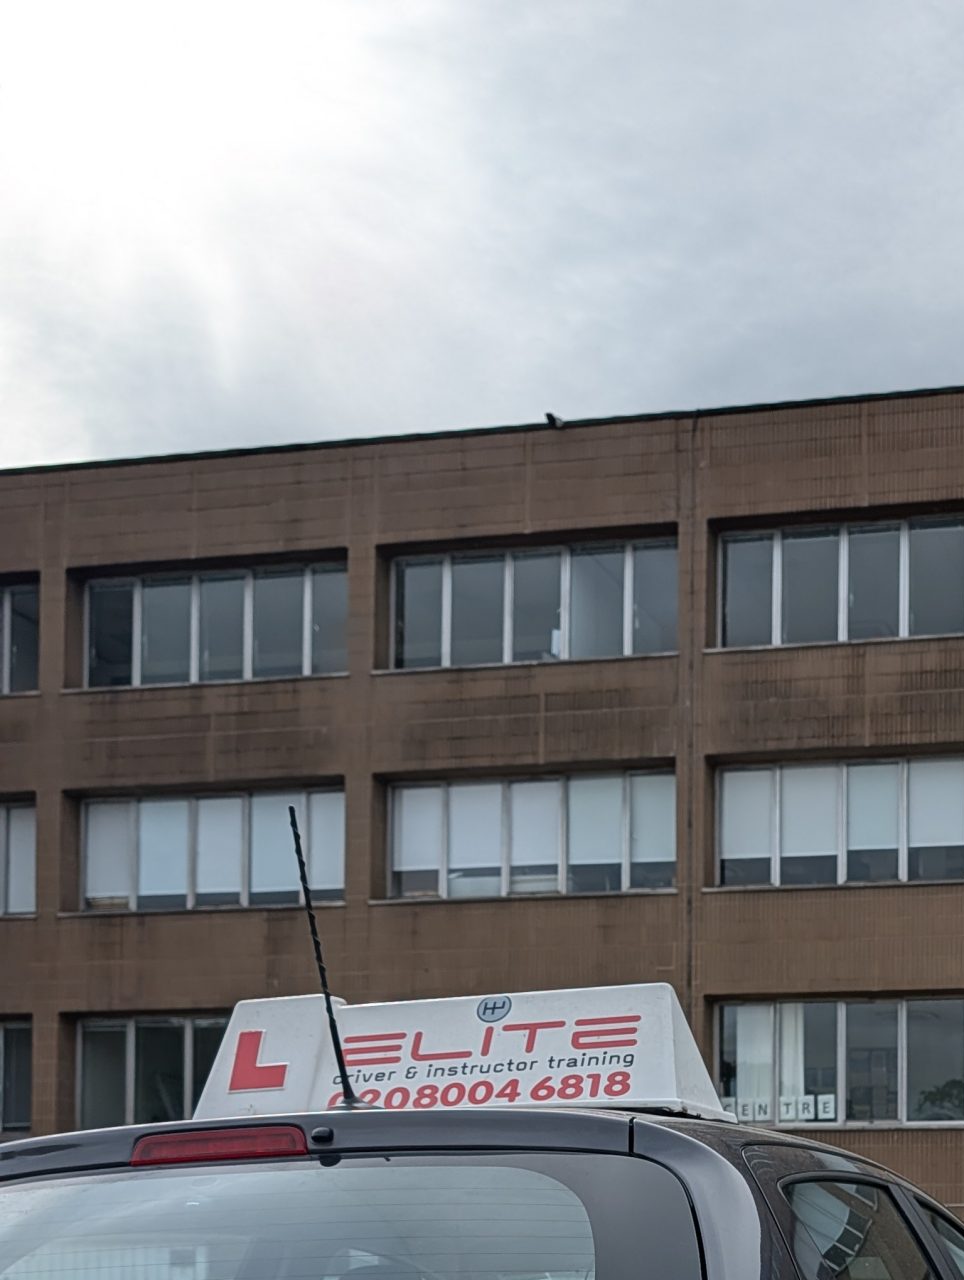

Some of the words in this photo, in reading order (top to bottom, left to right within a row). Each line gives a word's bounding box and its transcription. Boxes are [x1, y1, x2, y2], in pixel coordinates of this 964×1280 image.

[229, 1030, 289, 1091] L
[342, 1014, 642, 1067] ELITE
[405, 1066, 418, 1080] &
[426, 1055, 538, 1078] instructor
[548, 1050, 635, 1069] training
[530, 1070, 631, 1101] 6818
